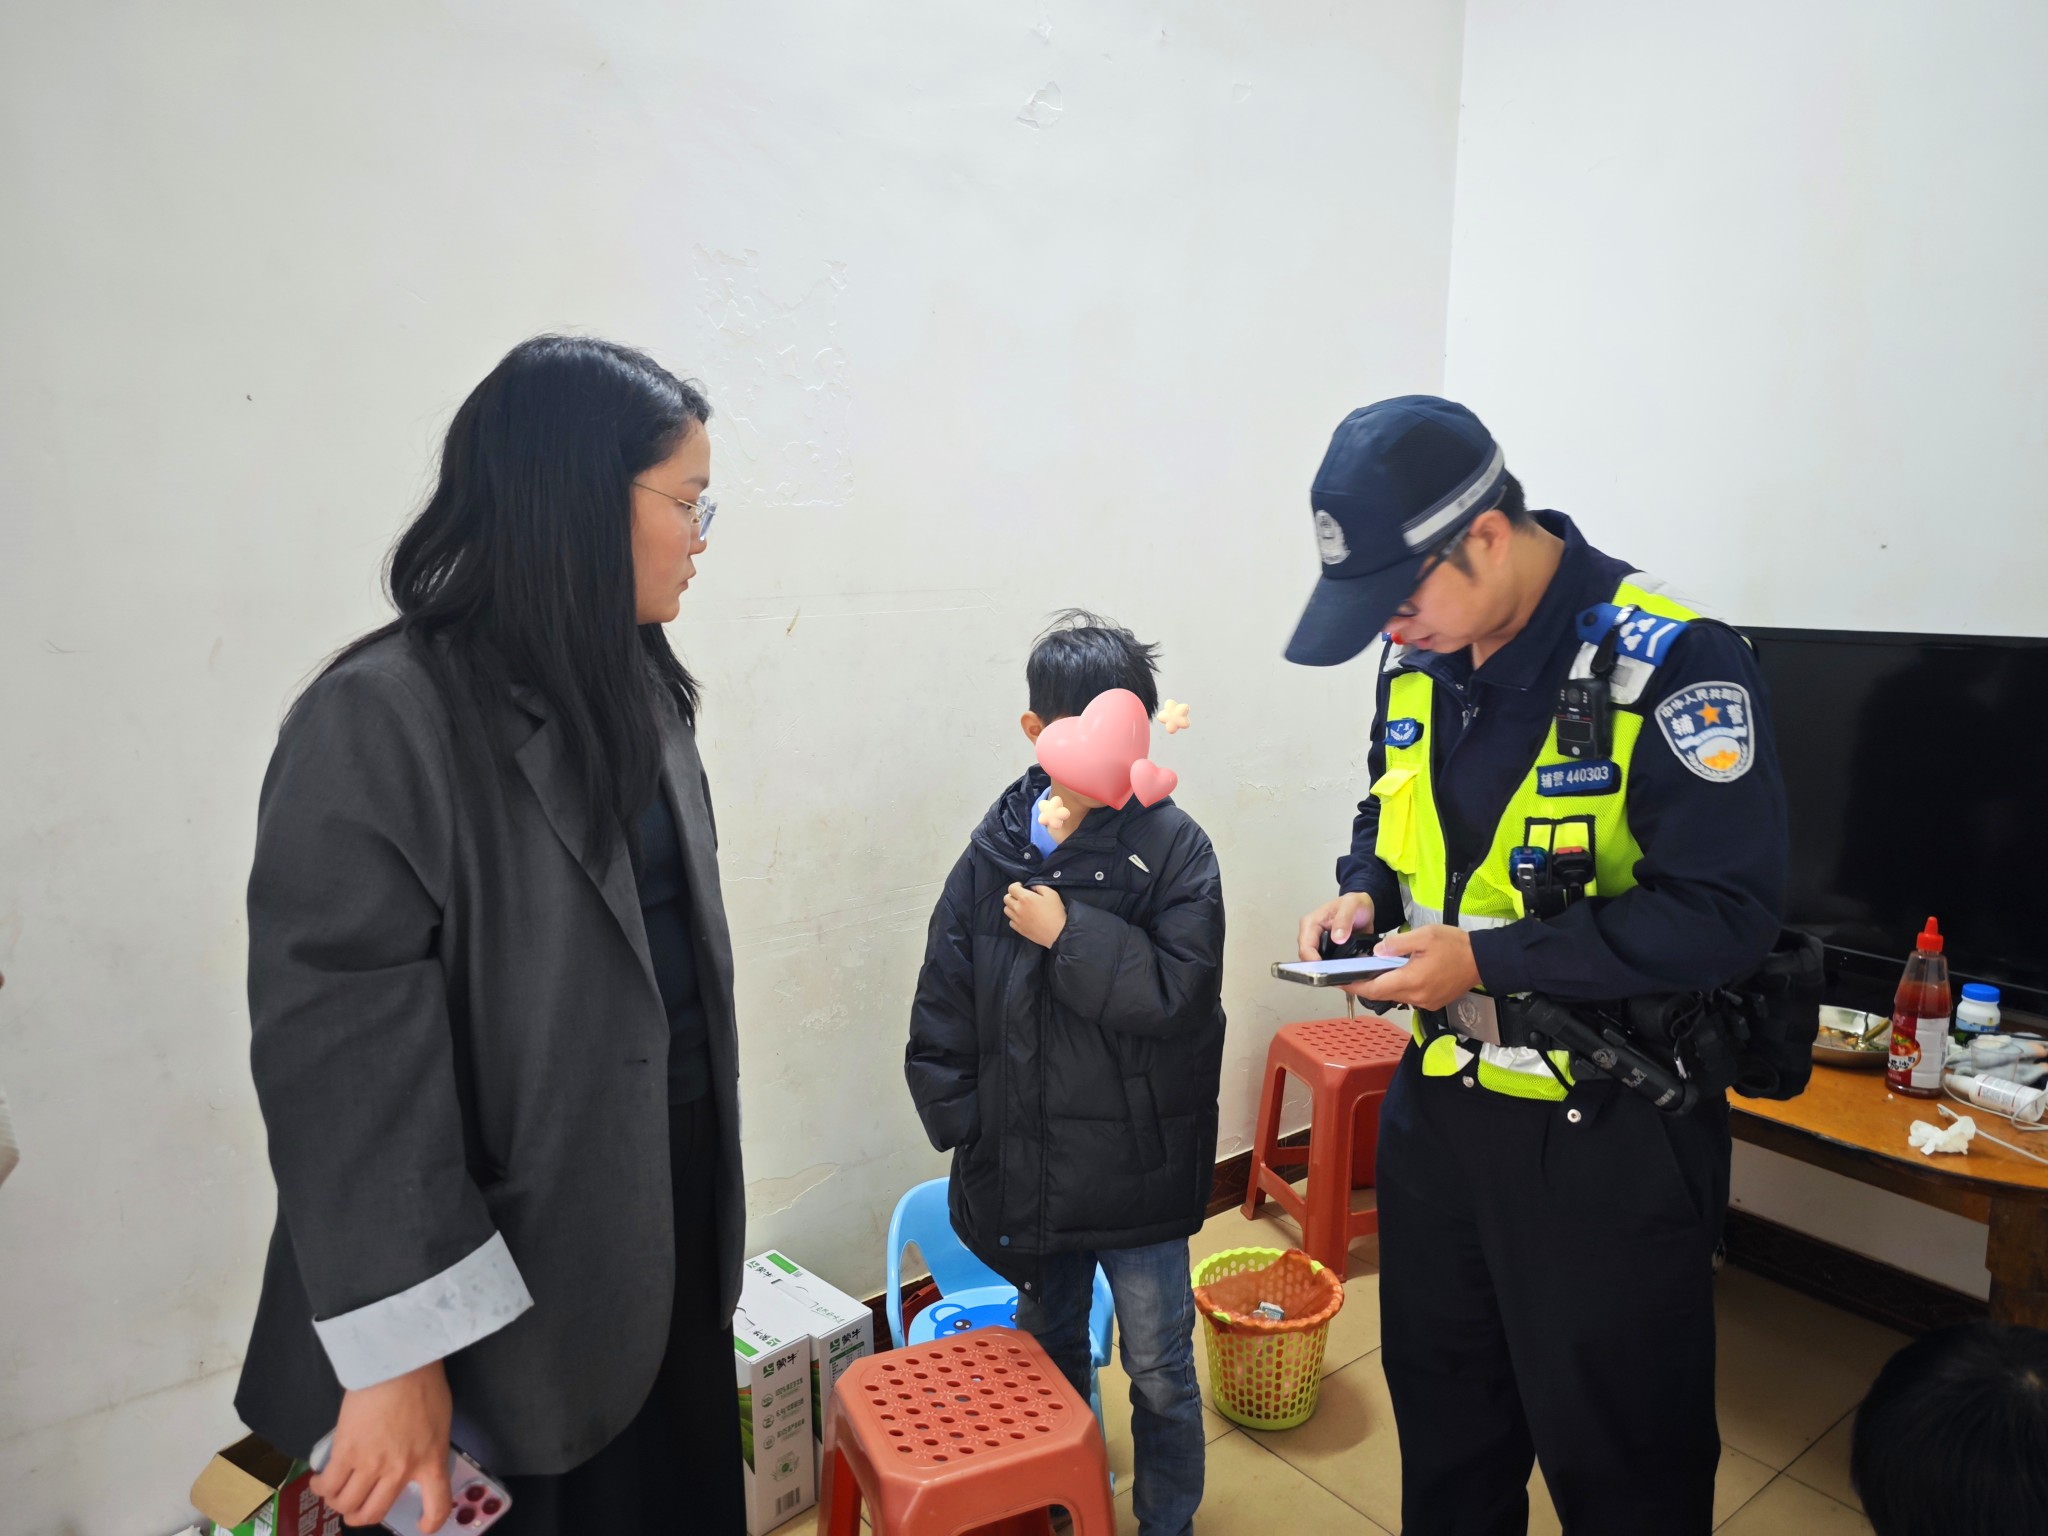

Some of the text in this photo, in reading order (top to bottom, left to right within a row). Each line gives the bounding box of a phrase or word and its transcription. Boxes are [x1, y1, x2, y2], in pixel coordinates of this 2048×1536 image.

[1540, 765, 1609, 789] 辅警 440303
[755, 1266, 773, 1278] 蒙牛
[841, 1327, 861, 1346] 蒙牛
[776, 1352, 798, 1371] 蒙牛
